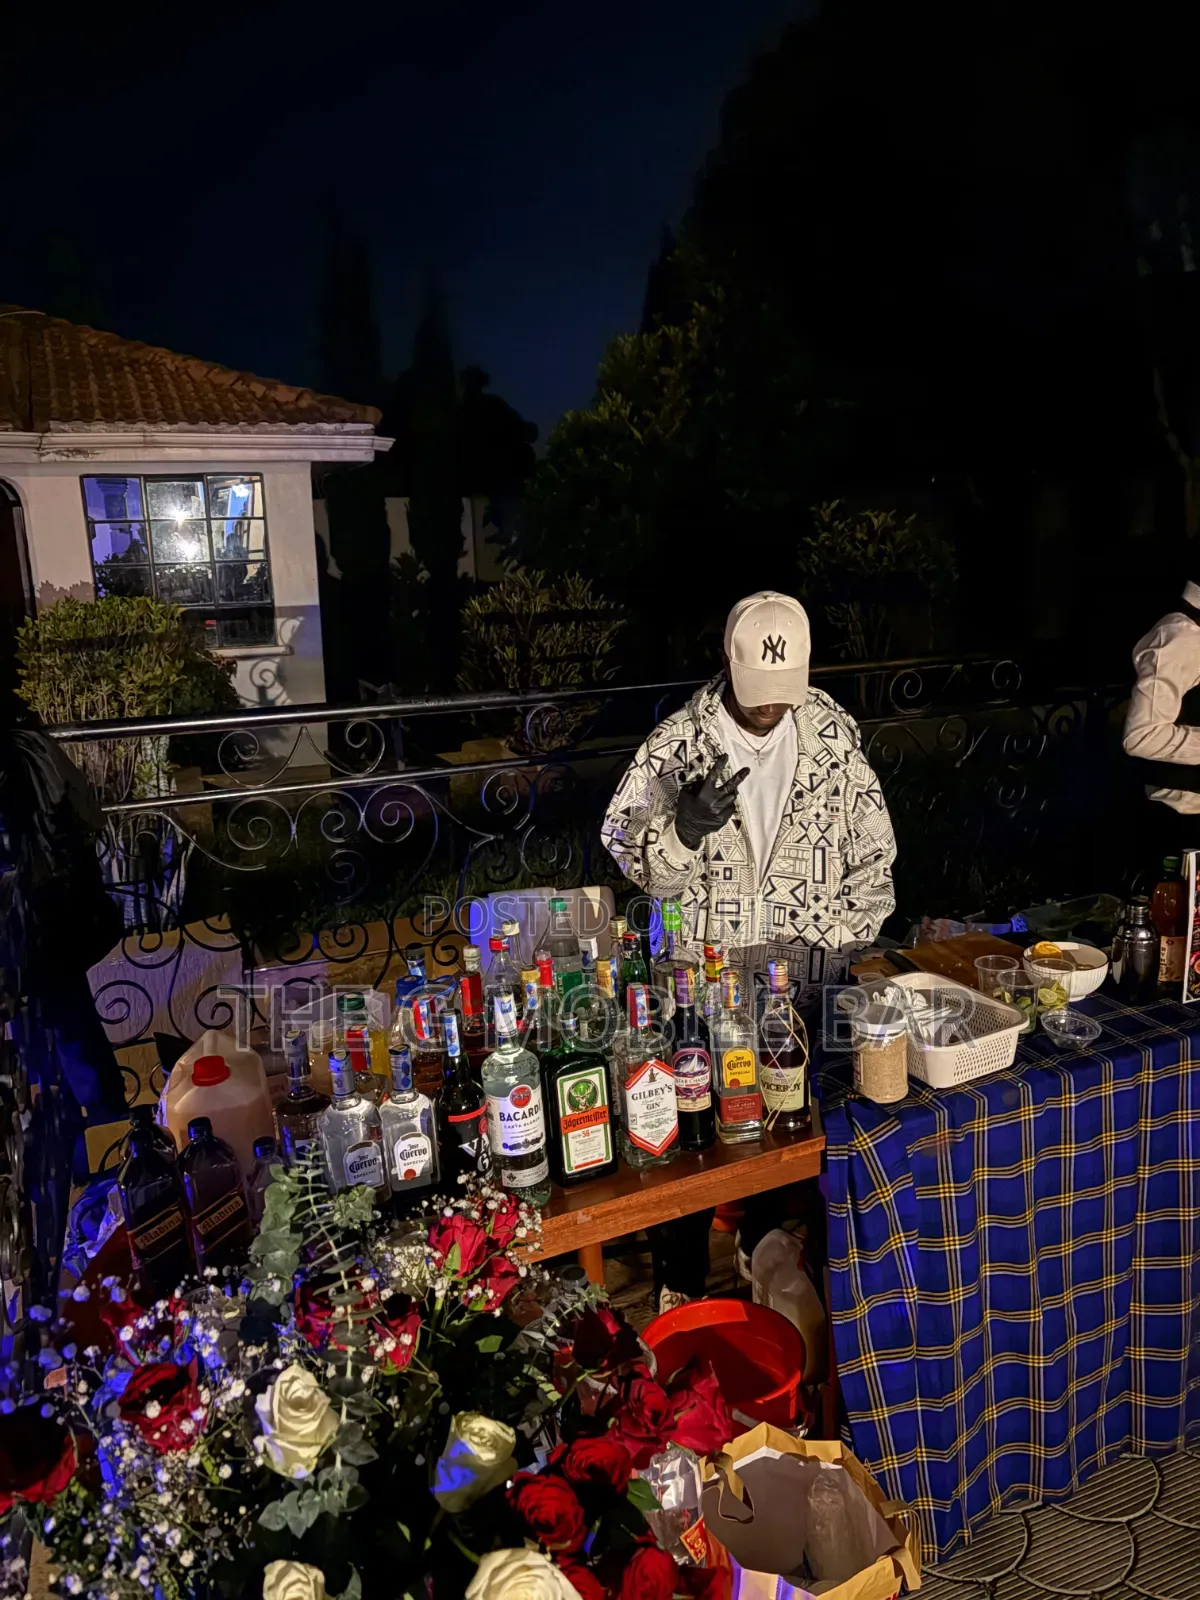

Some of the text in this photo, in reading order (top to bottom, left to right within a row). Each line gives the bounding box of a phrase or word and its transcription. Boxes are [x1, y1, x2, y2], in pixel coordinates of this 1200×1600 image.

[762, 634, 787, 664] NY
[631, 1083, 673, 1101] GILBEY'S
[646, 1102, 661, 1111] GIN
[400, 1147, 428, 1161] Cuervo
[349, 1158, 377, 1174] Cuervo
